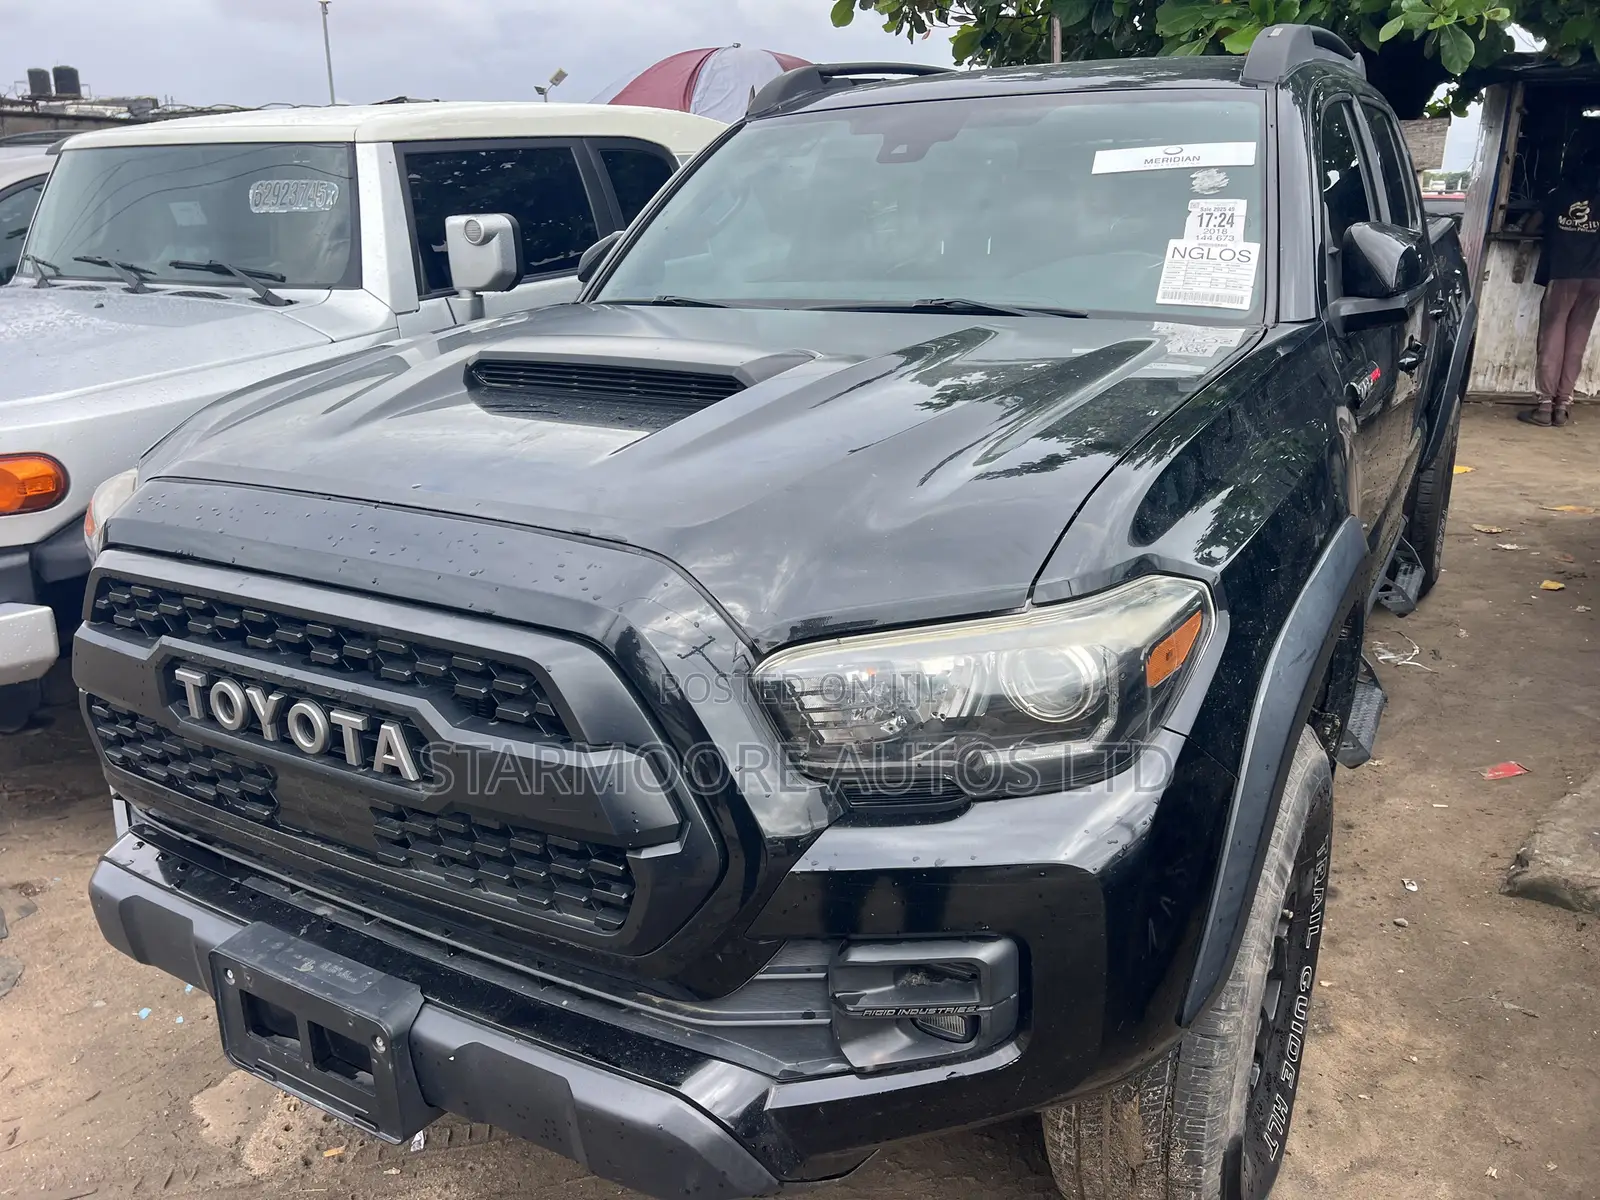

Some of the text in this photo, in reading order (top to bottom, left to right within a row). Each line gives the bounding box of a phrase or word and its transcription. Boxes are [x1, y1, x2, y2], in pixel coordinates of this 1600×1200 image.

[1143, 155, 1201, 165] MERIDIAN
[1197, 212, 1235, 228] 17:24
[1171, 246, 1252, 263] NGLOS
[174, 667, 421, 782] TOYOTA
[1304, 833, 1331, 950] TRAIL
[862, 1005, 977, 1017] RIGID INDUSTRIES
[1280, 965, 1313, 1090] GUIDE
